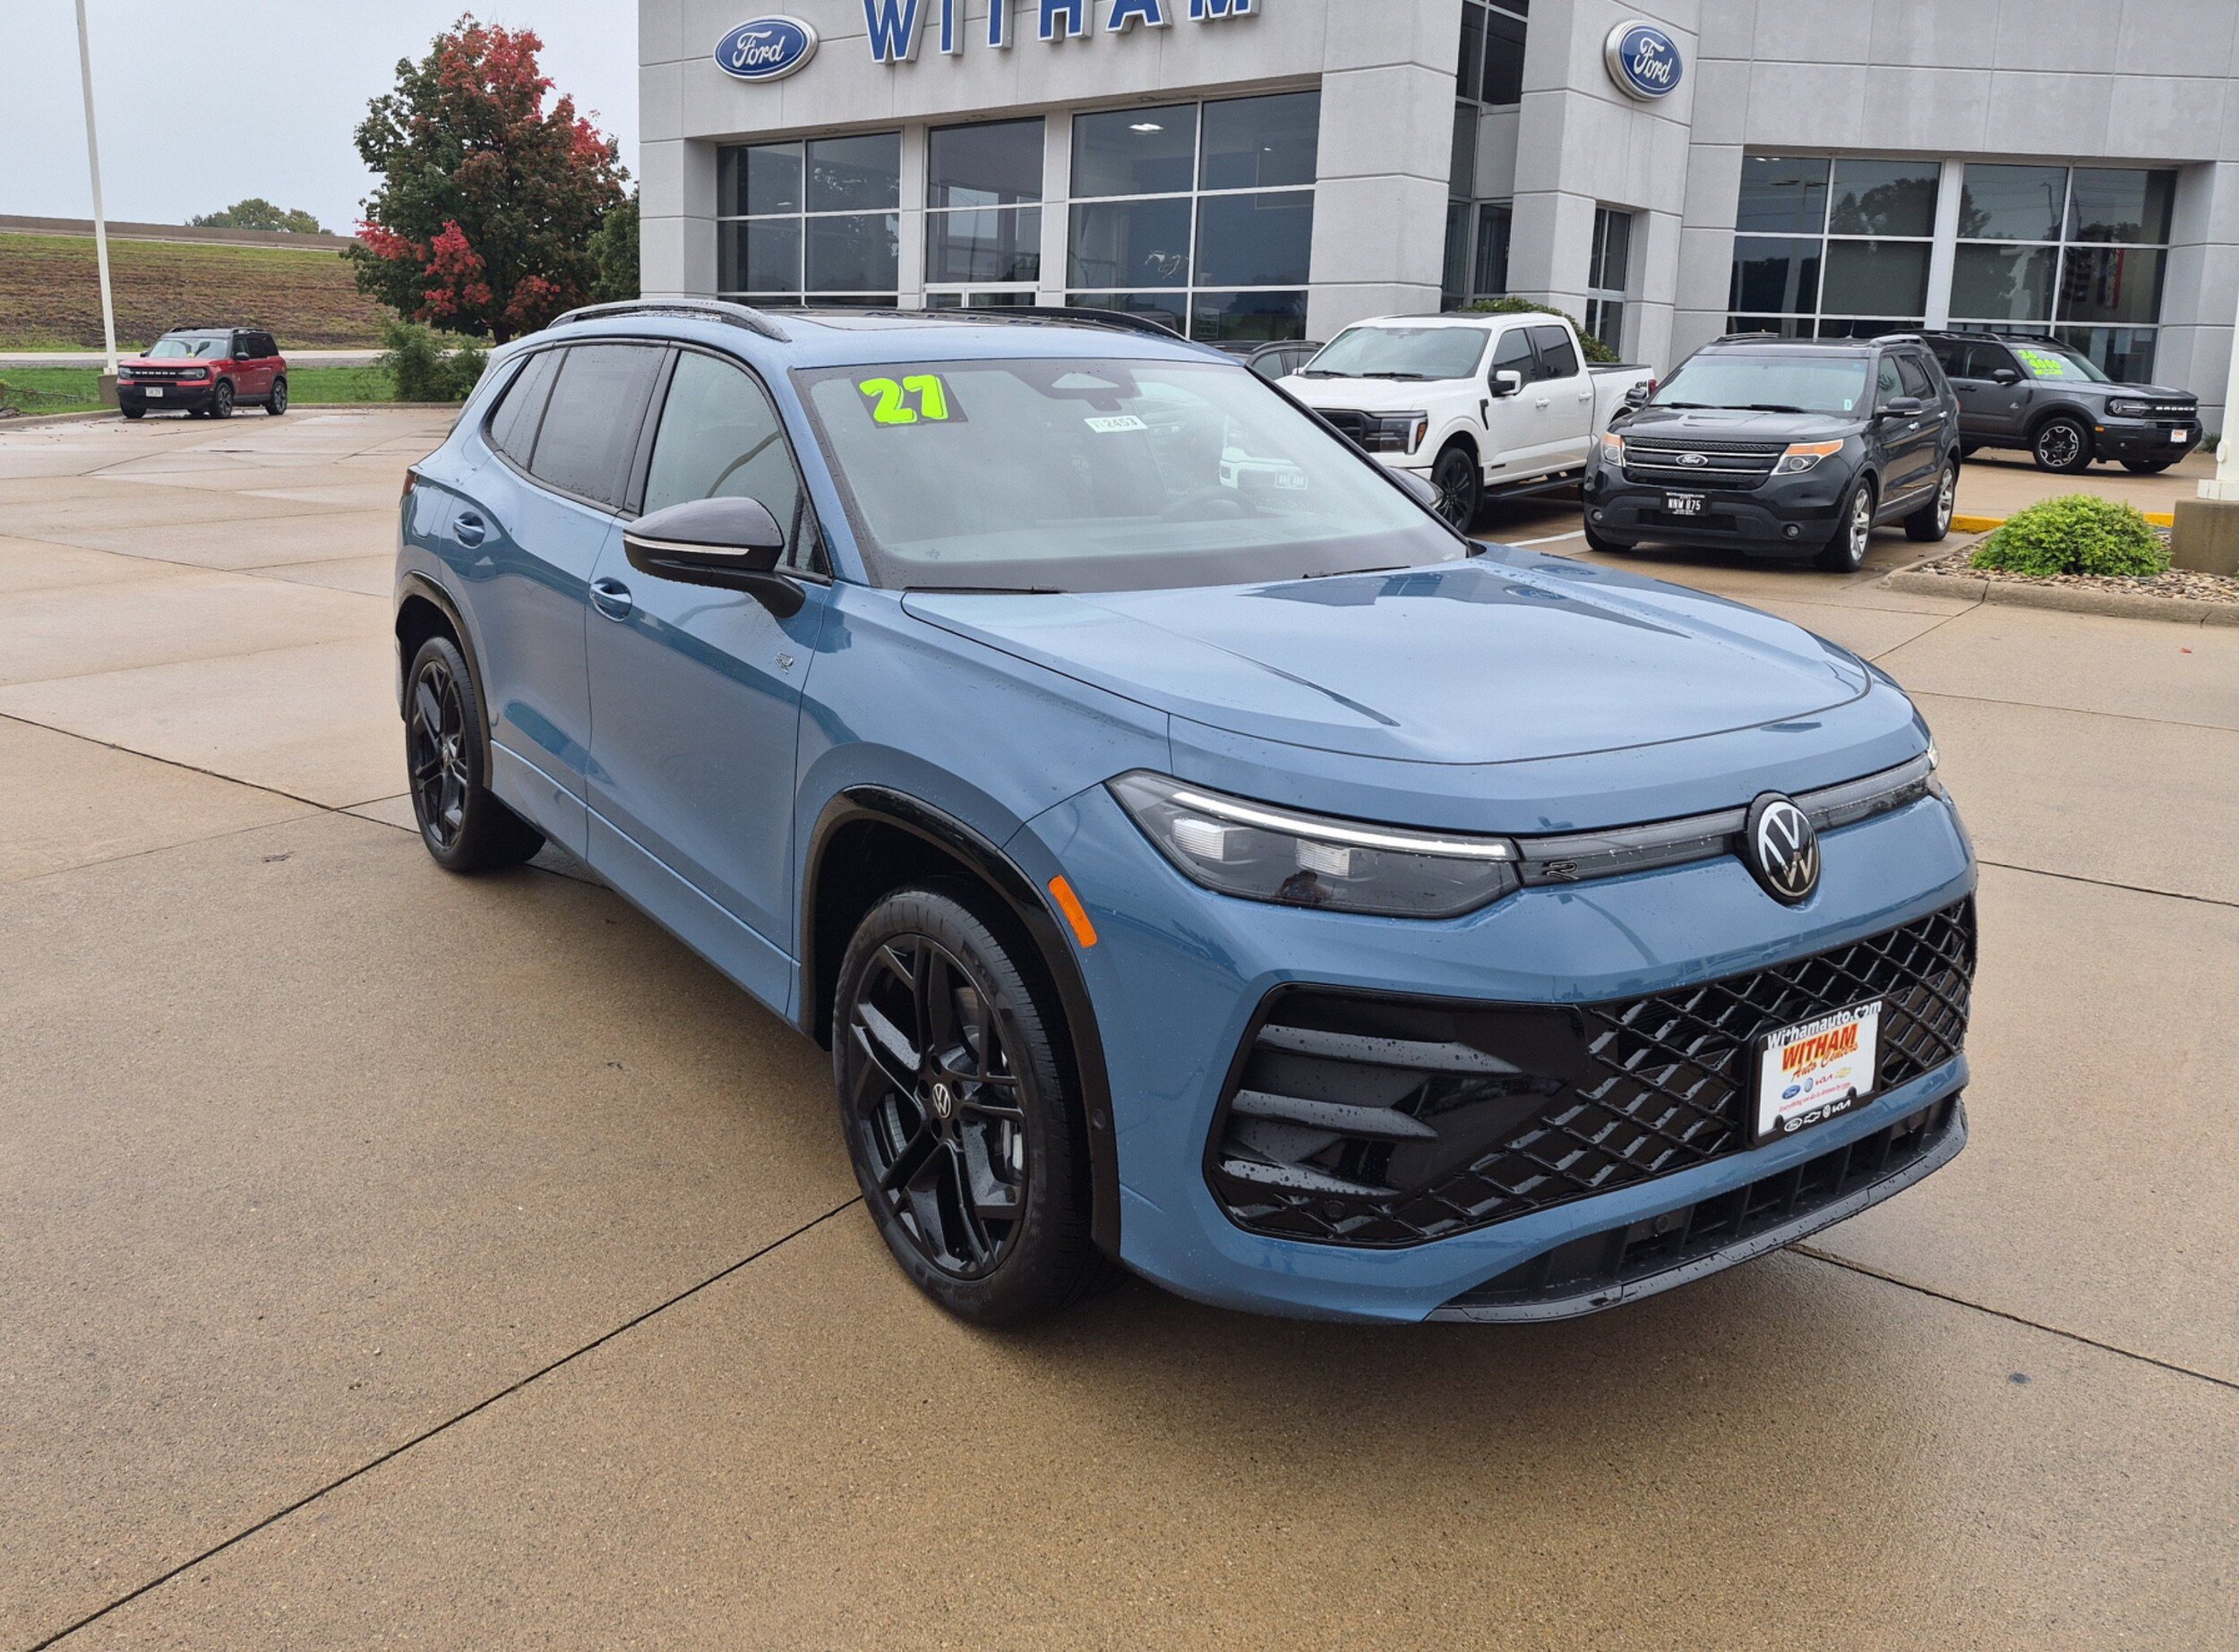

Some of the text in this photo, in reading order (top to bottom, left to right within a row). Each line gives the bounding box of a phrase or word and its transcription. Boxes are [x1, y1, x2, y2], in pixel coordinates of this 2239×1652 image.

[732, 30, 785, 67] Ford
[862, 0, 1254, 64] WITHA
[1634, 37, 1672, 83] Ford
[859, 374, 948, 424] 27
[1781, 1023, 1858, 1071] WITHAM
